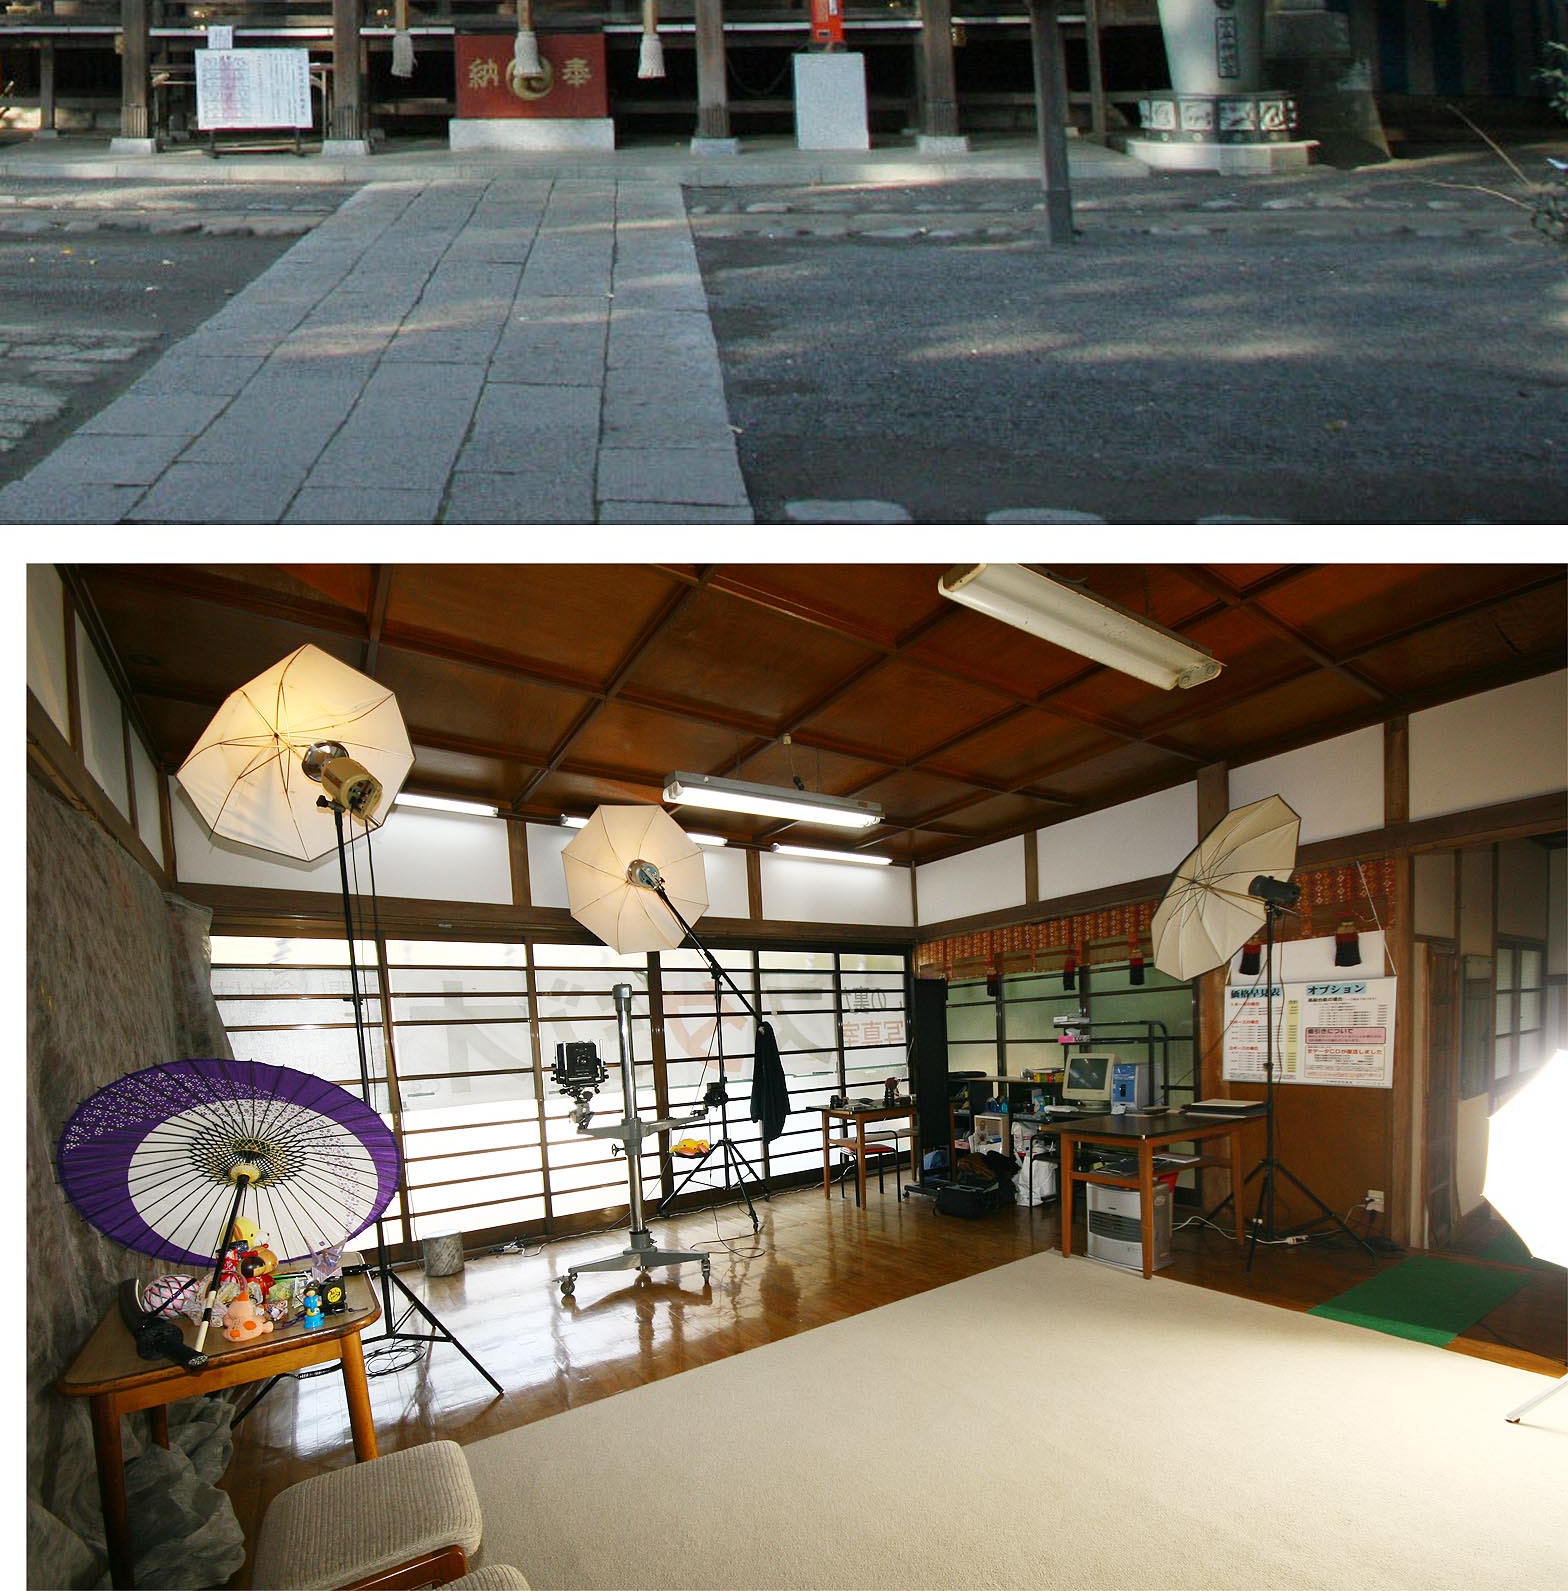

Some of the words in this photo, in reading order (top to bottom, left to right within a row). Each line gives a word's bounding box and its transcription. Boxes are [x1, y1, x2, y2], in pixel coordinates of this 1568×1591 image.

[1307, 984, 1365, 995] オプション
